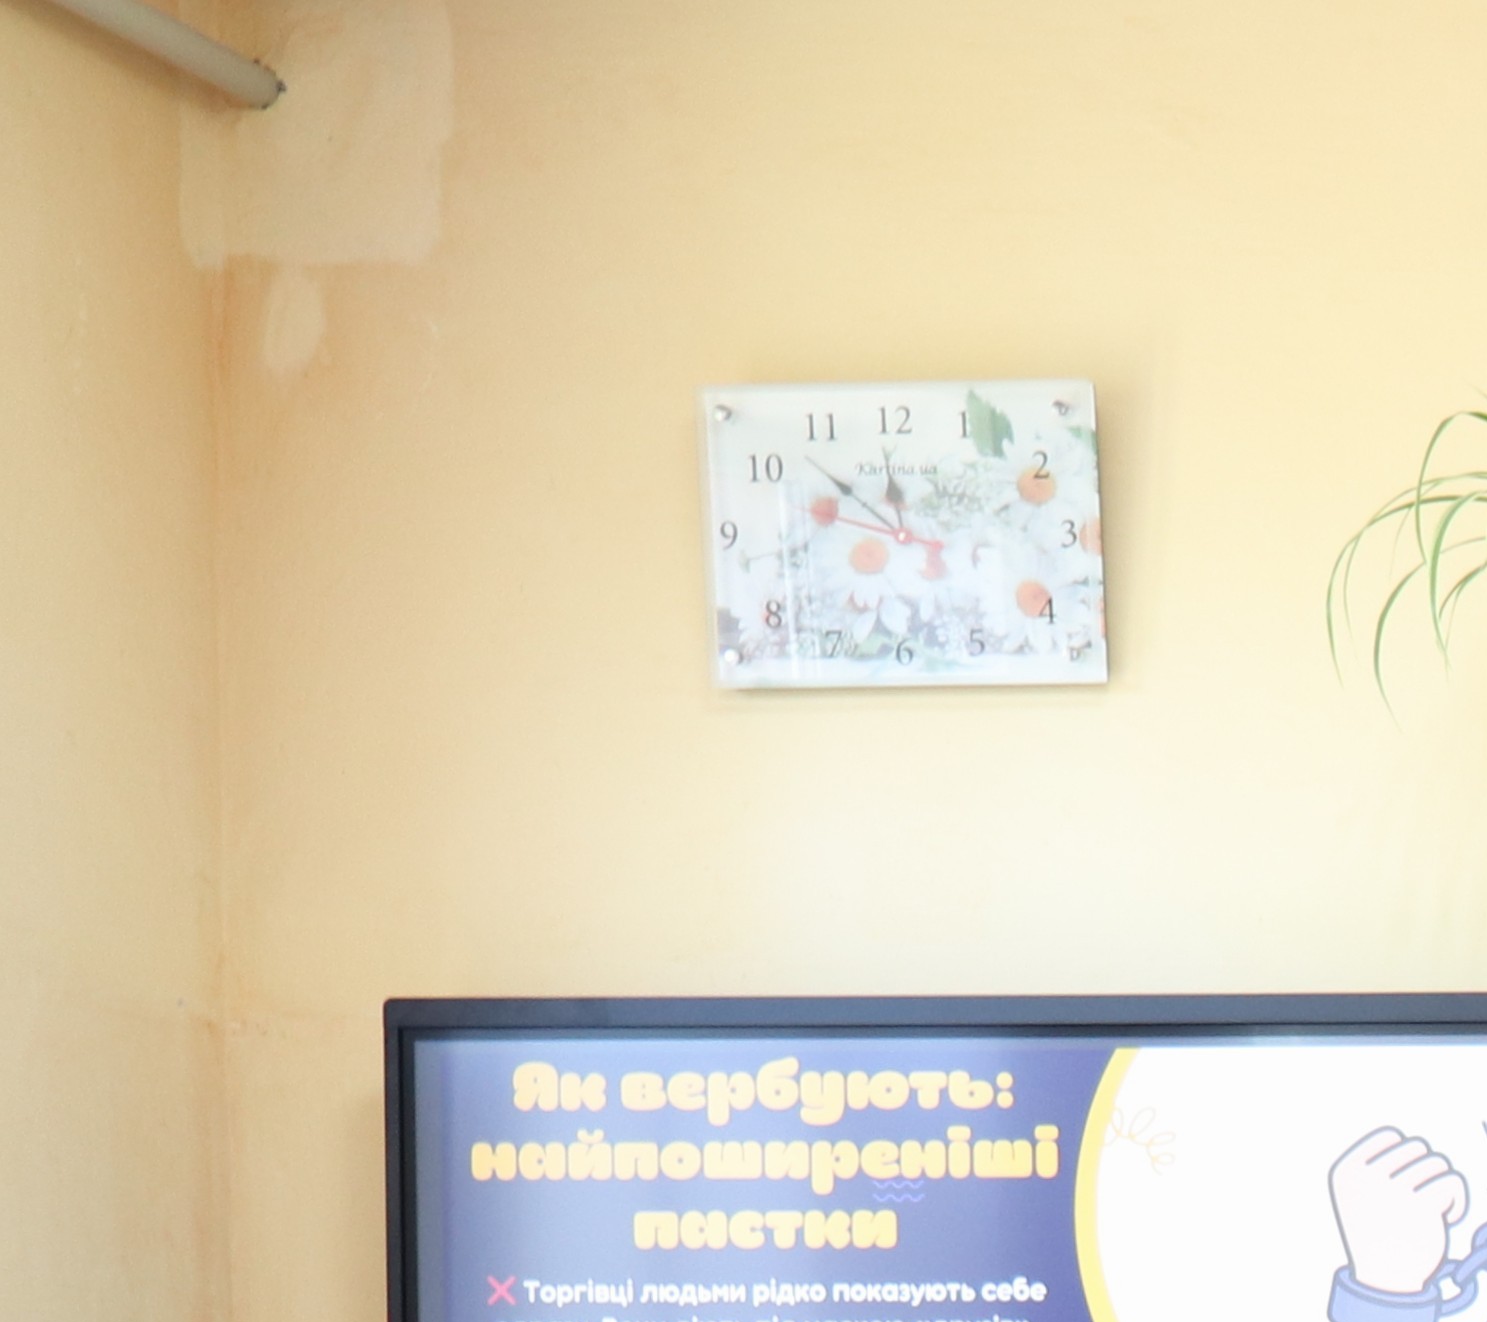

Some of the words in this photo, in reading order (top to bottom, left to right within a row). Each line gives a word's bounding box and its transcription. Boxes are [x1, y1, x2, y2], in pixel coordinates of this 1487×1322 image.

[805, 411, 839, 442] 11
[877, 404, 914, 436] 12
[958, 411, 971, 439] 1
[747, 453, 785, 485] 10
[1032, 451, 1052, 480] 2
[719, 520, 739, 551] 9
[1060, 519, 1079, 549] 3
[764, 600, 784, 630] 8
[1037, 596, 1058, 626] 4
[823, 628, 843, 659] 7
[895, 637, 915, 666] 6
[968, 628, 987, 658] 5
[512, 1060, 607, 1112] Як
[620, 1056, 1015, 1127] вербують:
[470, 1124, 1060, 1196] найпоширеніші
[632, 1208, 899, 1250] пастки
[523, 1278, 635, 1308] Торгівці
[640, 1280, 748, 1307] людьми
[753, 1278, 828, 1308] рідко
[833, 1280, 977, 1308] показують
[980, 1276, 1048, 1303] себе
